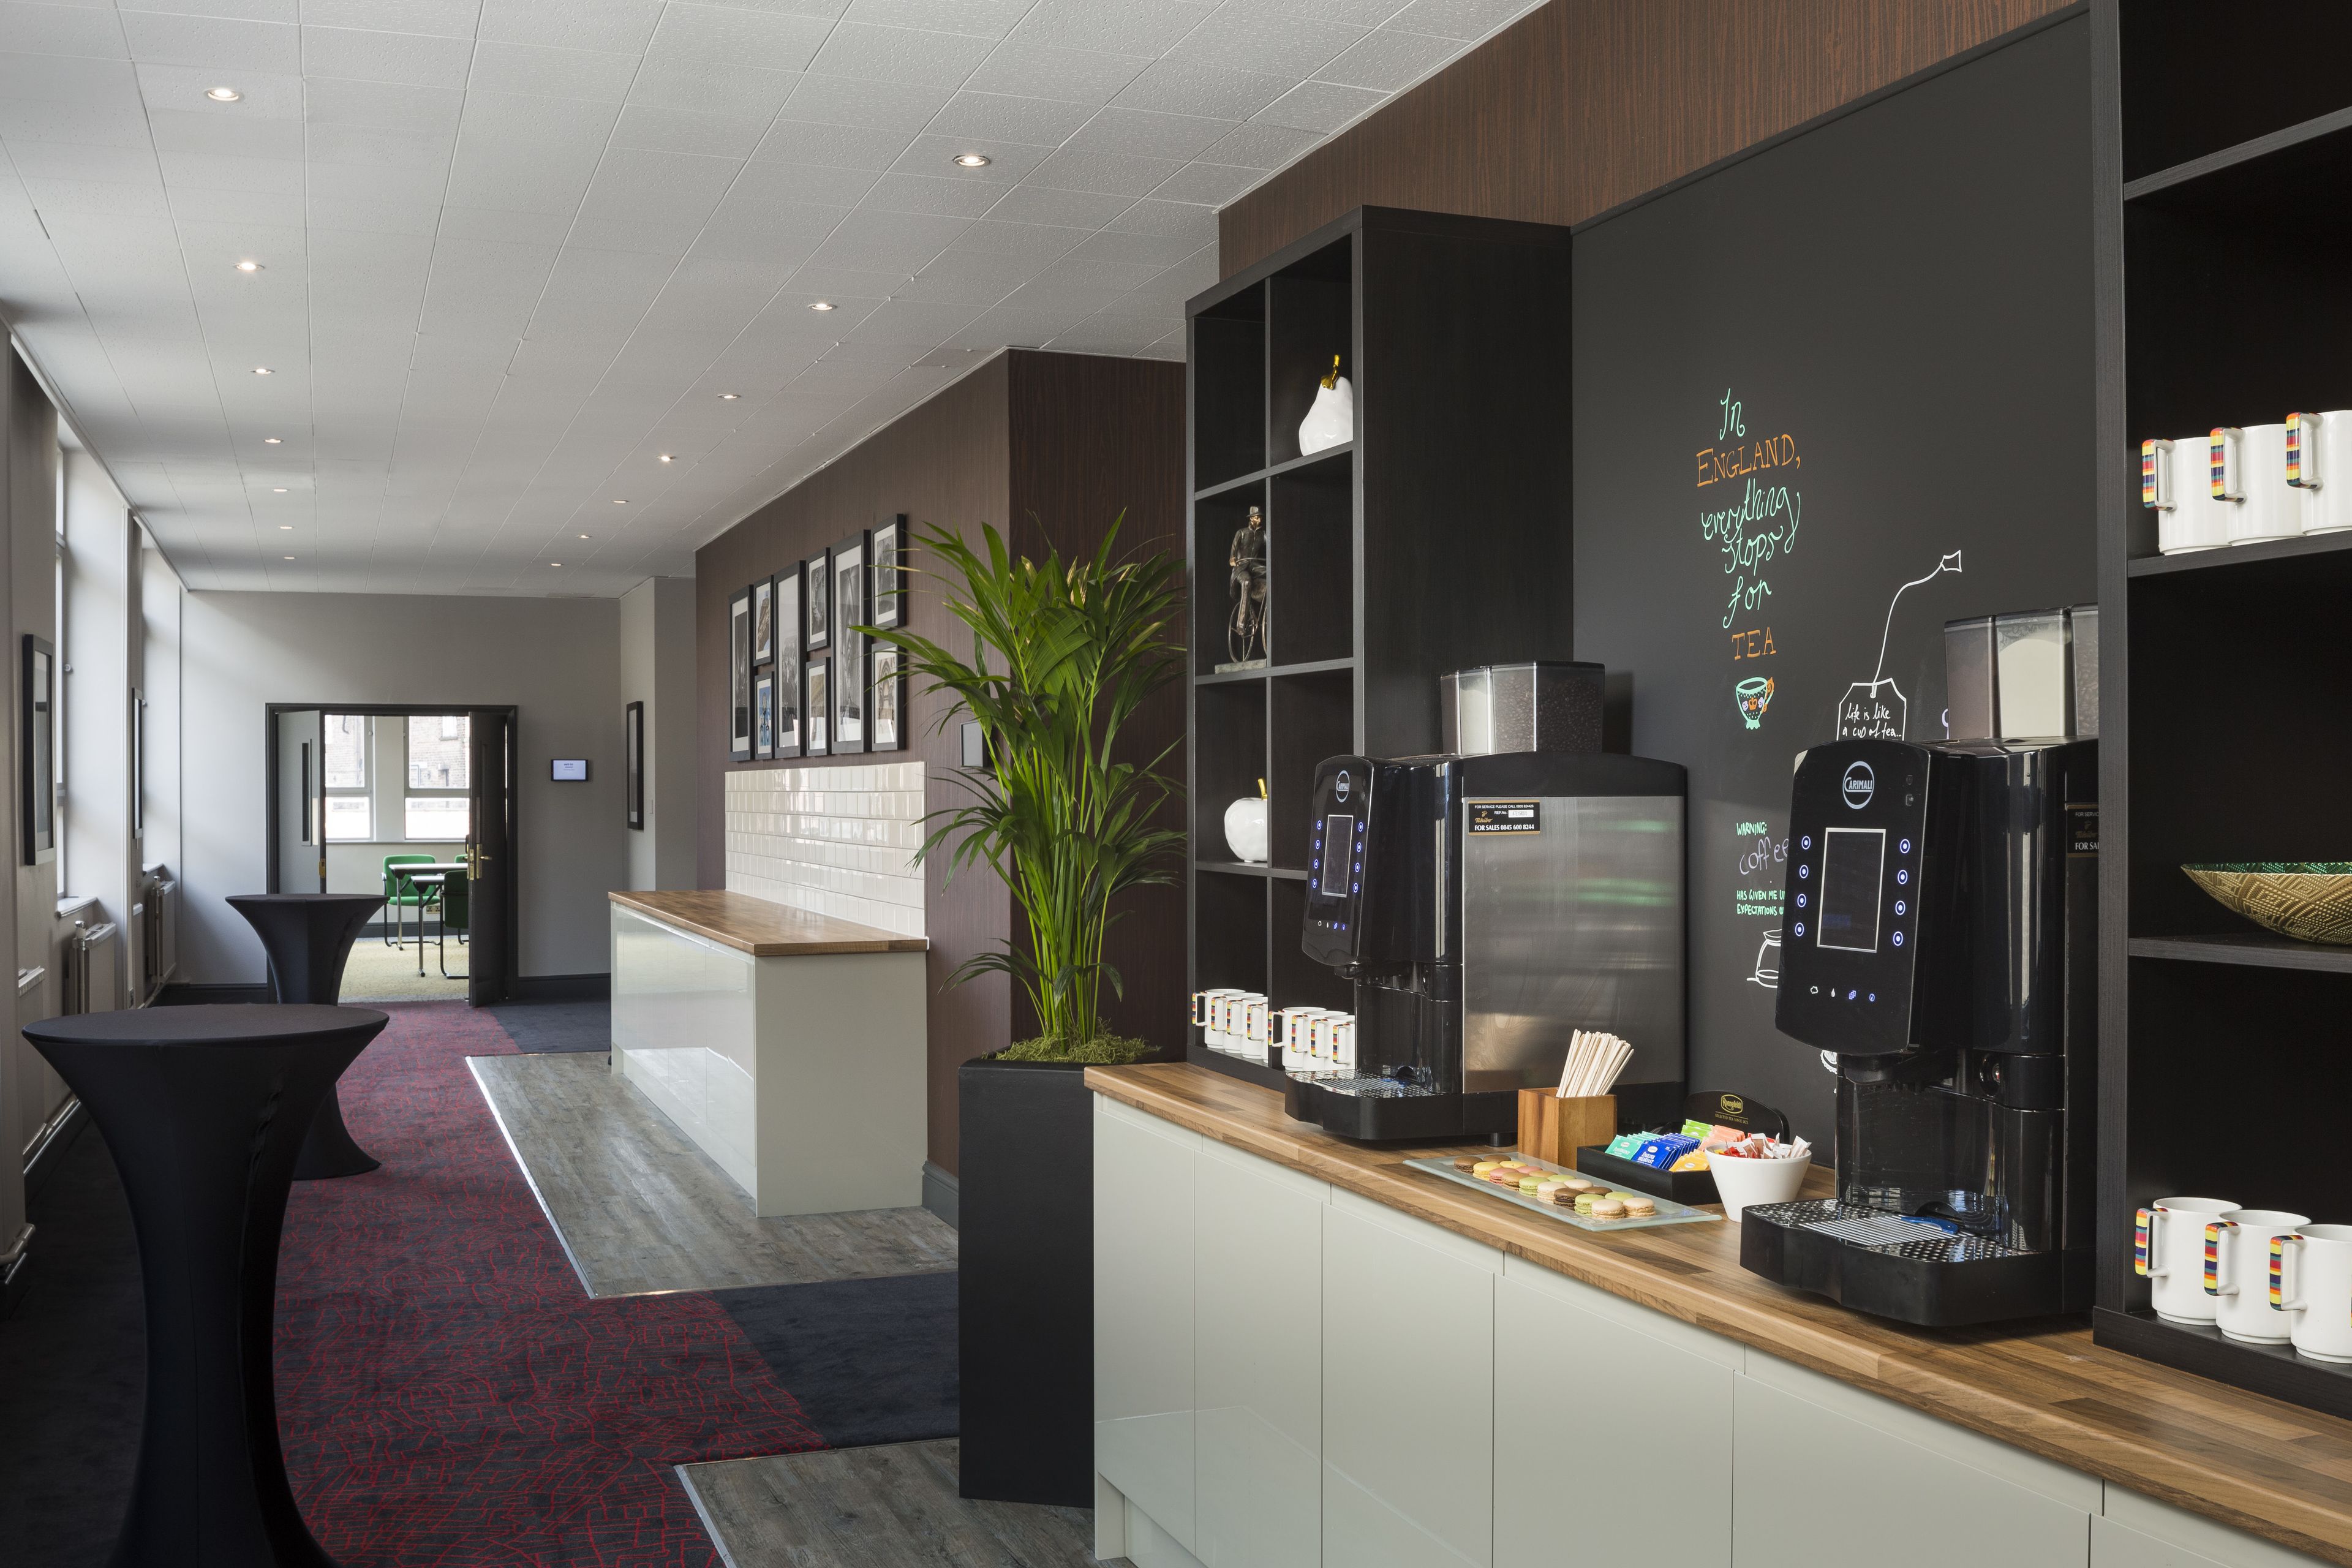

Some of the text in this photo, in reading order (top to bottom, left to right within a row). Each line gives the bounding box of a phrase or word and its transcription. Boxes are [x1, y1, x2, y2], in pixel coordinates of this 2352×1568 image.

[1722, 576, 1772, 629] for
[1732, 627, 1776, 660] TEA
[1864, 707, 1870, 720] is
[1872, 702, 1891, 720] like
[1842, 726, 1848, 737] a
[1844, 777, 1873, 793] CARIMALI
[1736, 821, 1767, 836] WARNING:
[1736, 890, 1747, 900] HAS
[1749, 889, 1766, 901] GIVEN
[1768, 890, 1777, 900] ME
[1736, 903, 1777, 916] EXPECTATIONS
